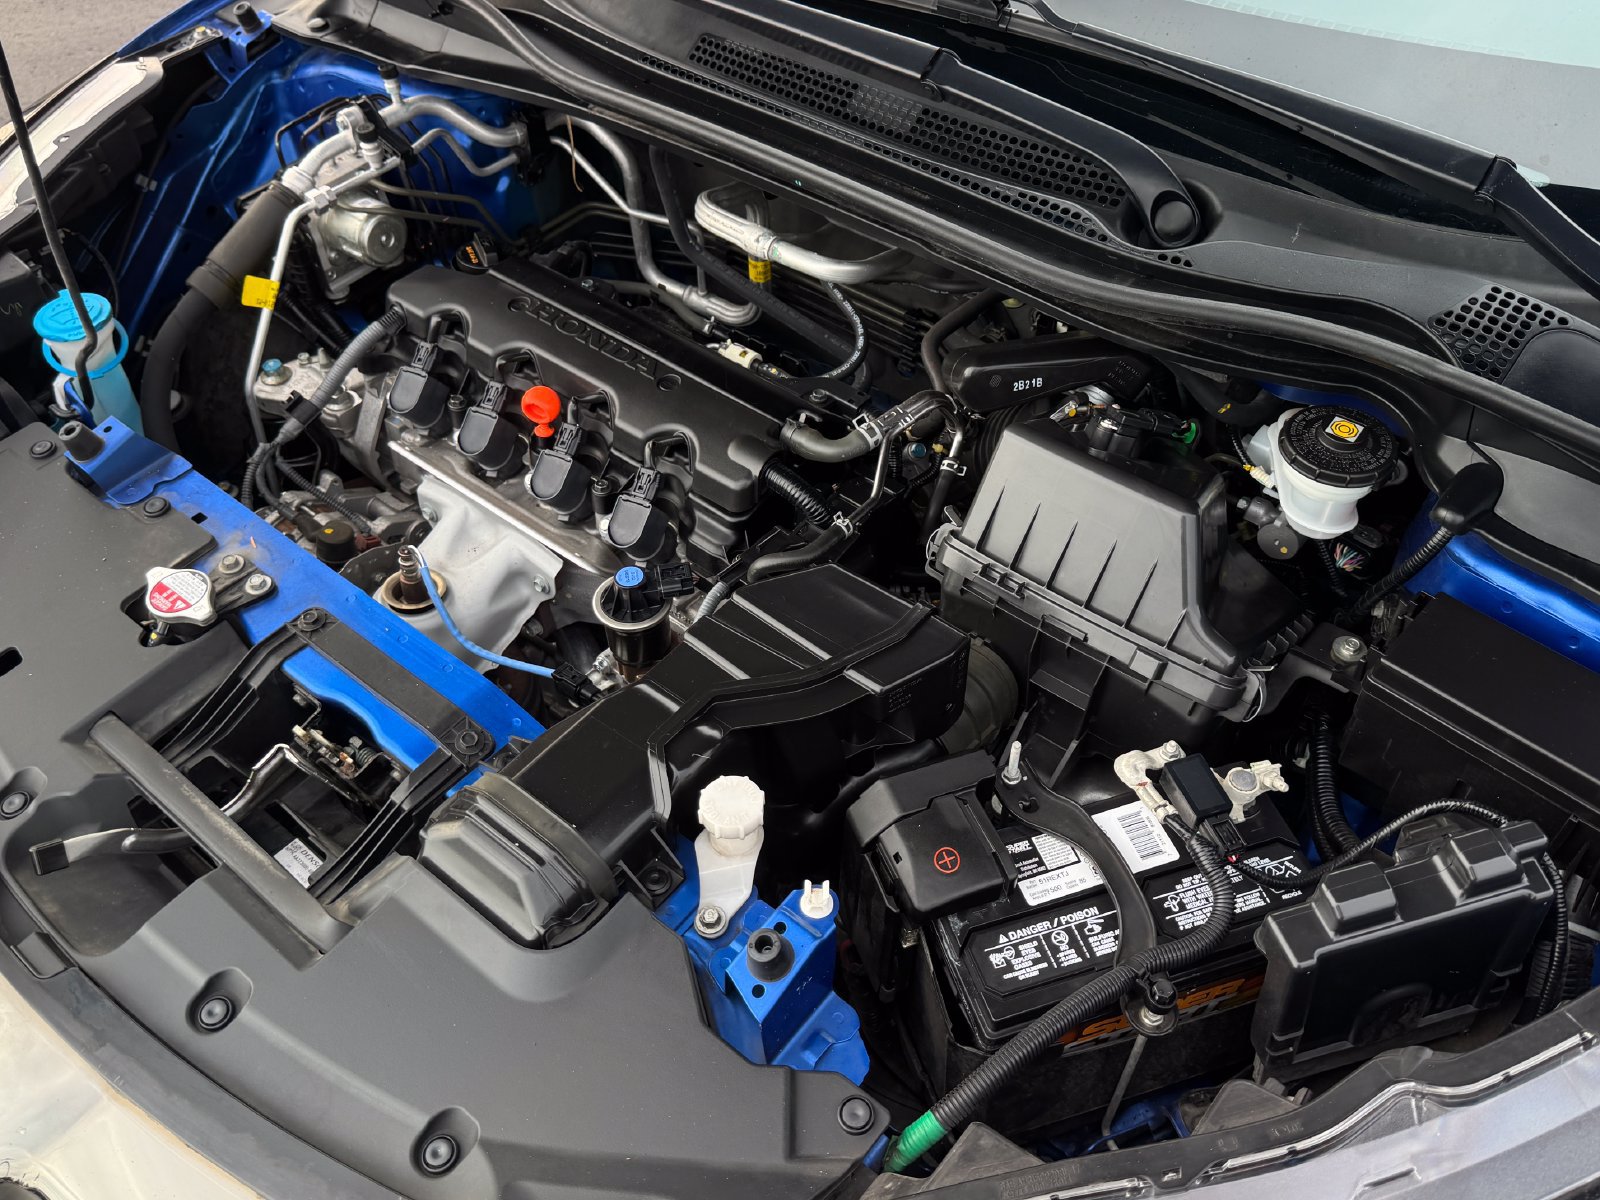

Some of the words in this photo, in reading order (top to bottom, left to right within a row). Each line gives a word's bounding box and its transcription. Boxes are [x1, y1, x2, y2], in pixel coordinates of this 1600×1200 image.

[525, 298, 657, 381] HONDA
[1008, 920, 1052, 940] DANGER
[1060, 906, 1099, 924] POISON
